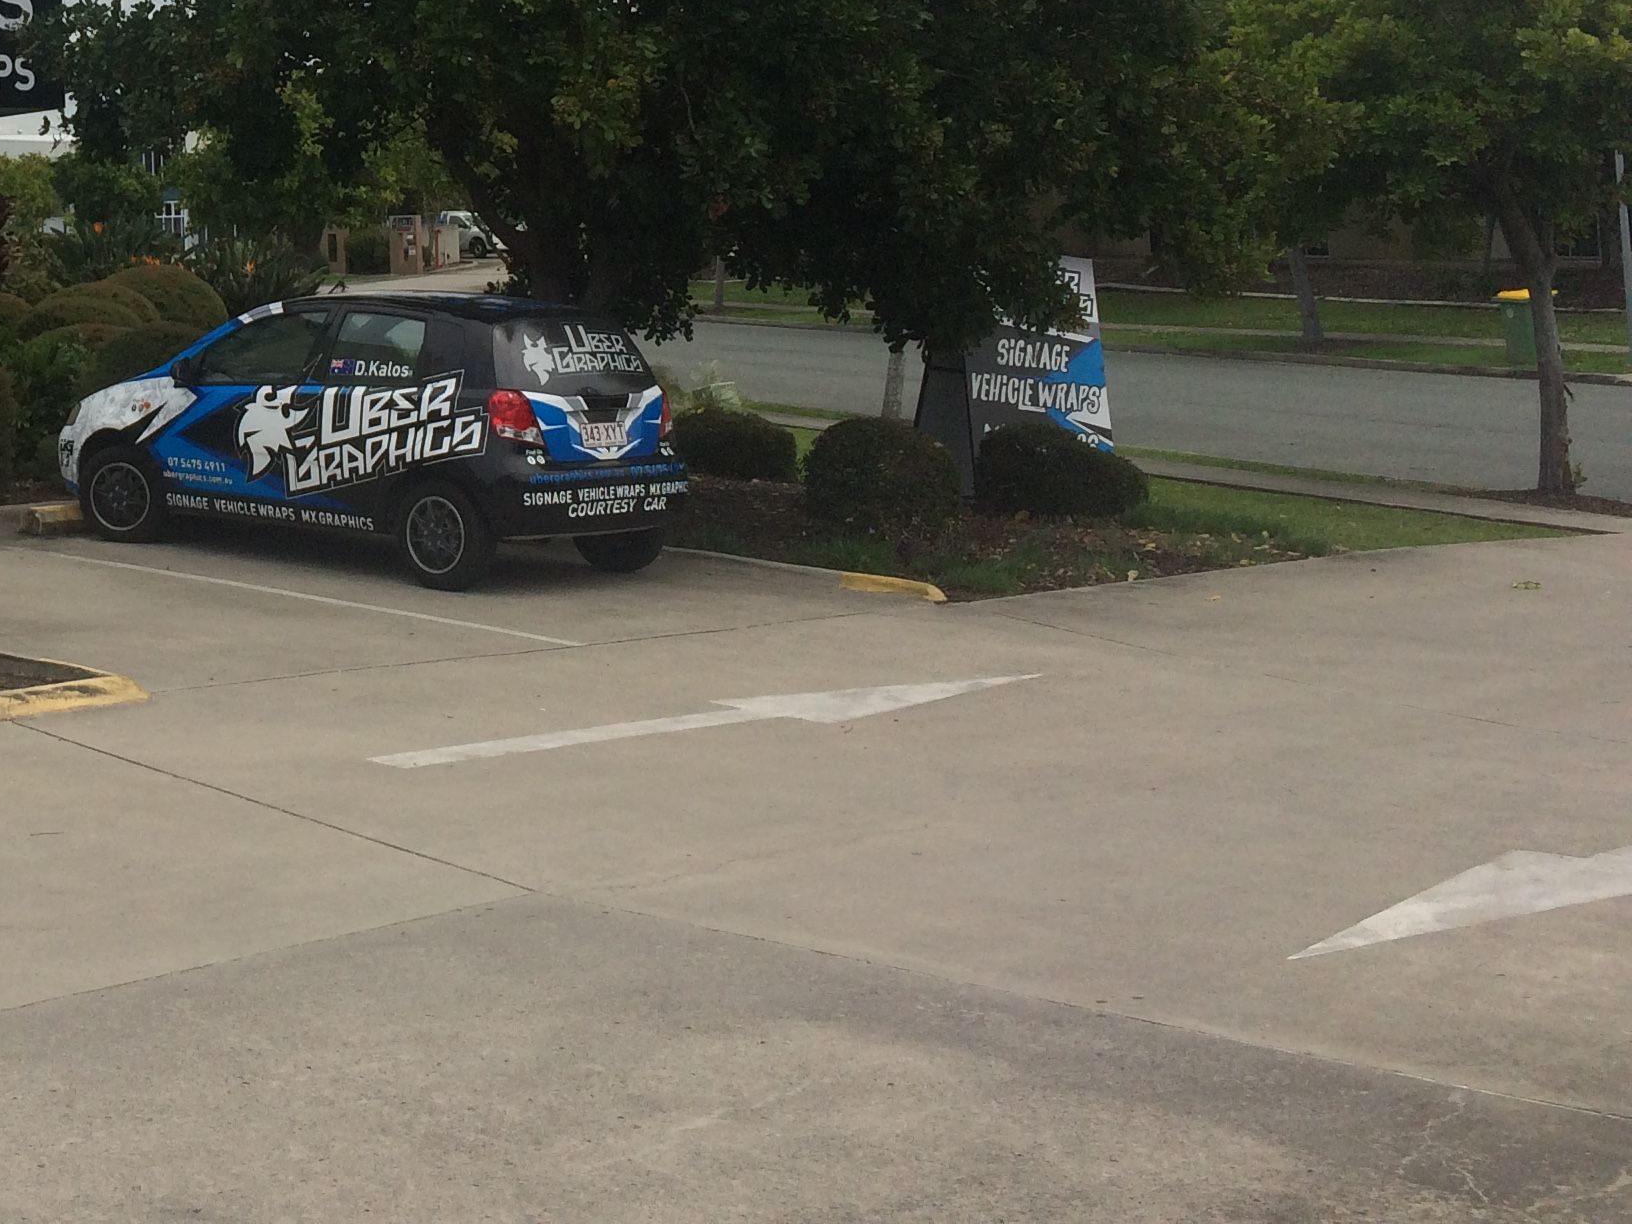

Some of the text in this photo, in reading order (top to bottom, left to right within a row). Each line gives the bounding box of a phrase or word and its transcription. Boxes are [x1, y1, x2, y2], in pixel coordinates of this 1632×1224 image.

[1037, 379, 1101, 414] WRAPS
[167, 456, 226, 473] 07 5475 4911
[523, 480, 689, 506] SIGNAGE VEHICLE WRAPS MX GRAPHIC
[165, 492, 375, 531] SIGNAGE VEHICLE WRAPS MX GRAPHICS
[568, 496, 668, 518] COURTESY CAR
